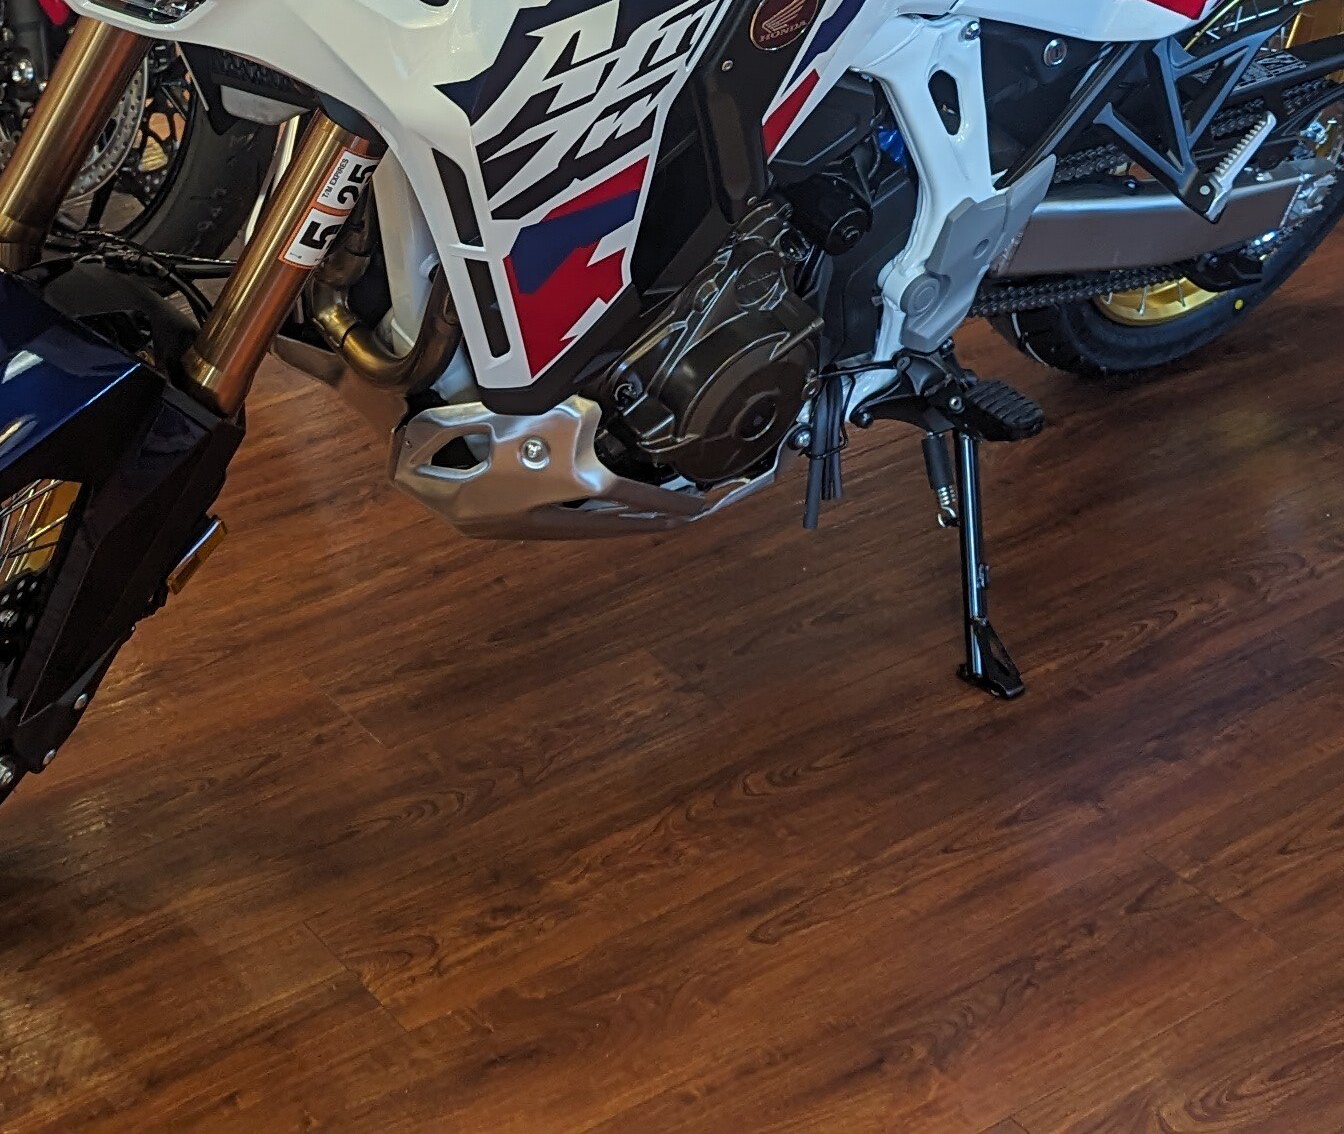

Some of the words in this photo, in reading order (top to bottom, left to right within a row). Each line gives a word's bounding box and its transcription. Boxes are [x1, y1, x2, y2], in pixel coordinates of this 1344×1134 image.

[759, 20, 808, 43] HONDA
[331, 157, 349, 187] EXPIRES
[337, 164, 379, 205] 25
[299, 220, 345, 250] 5
